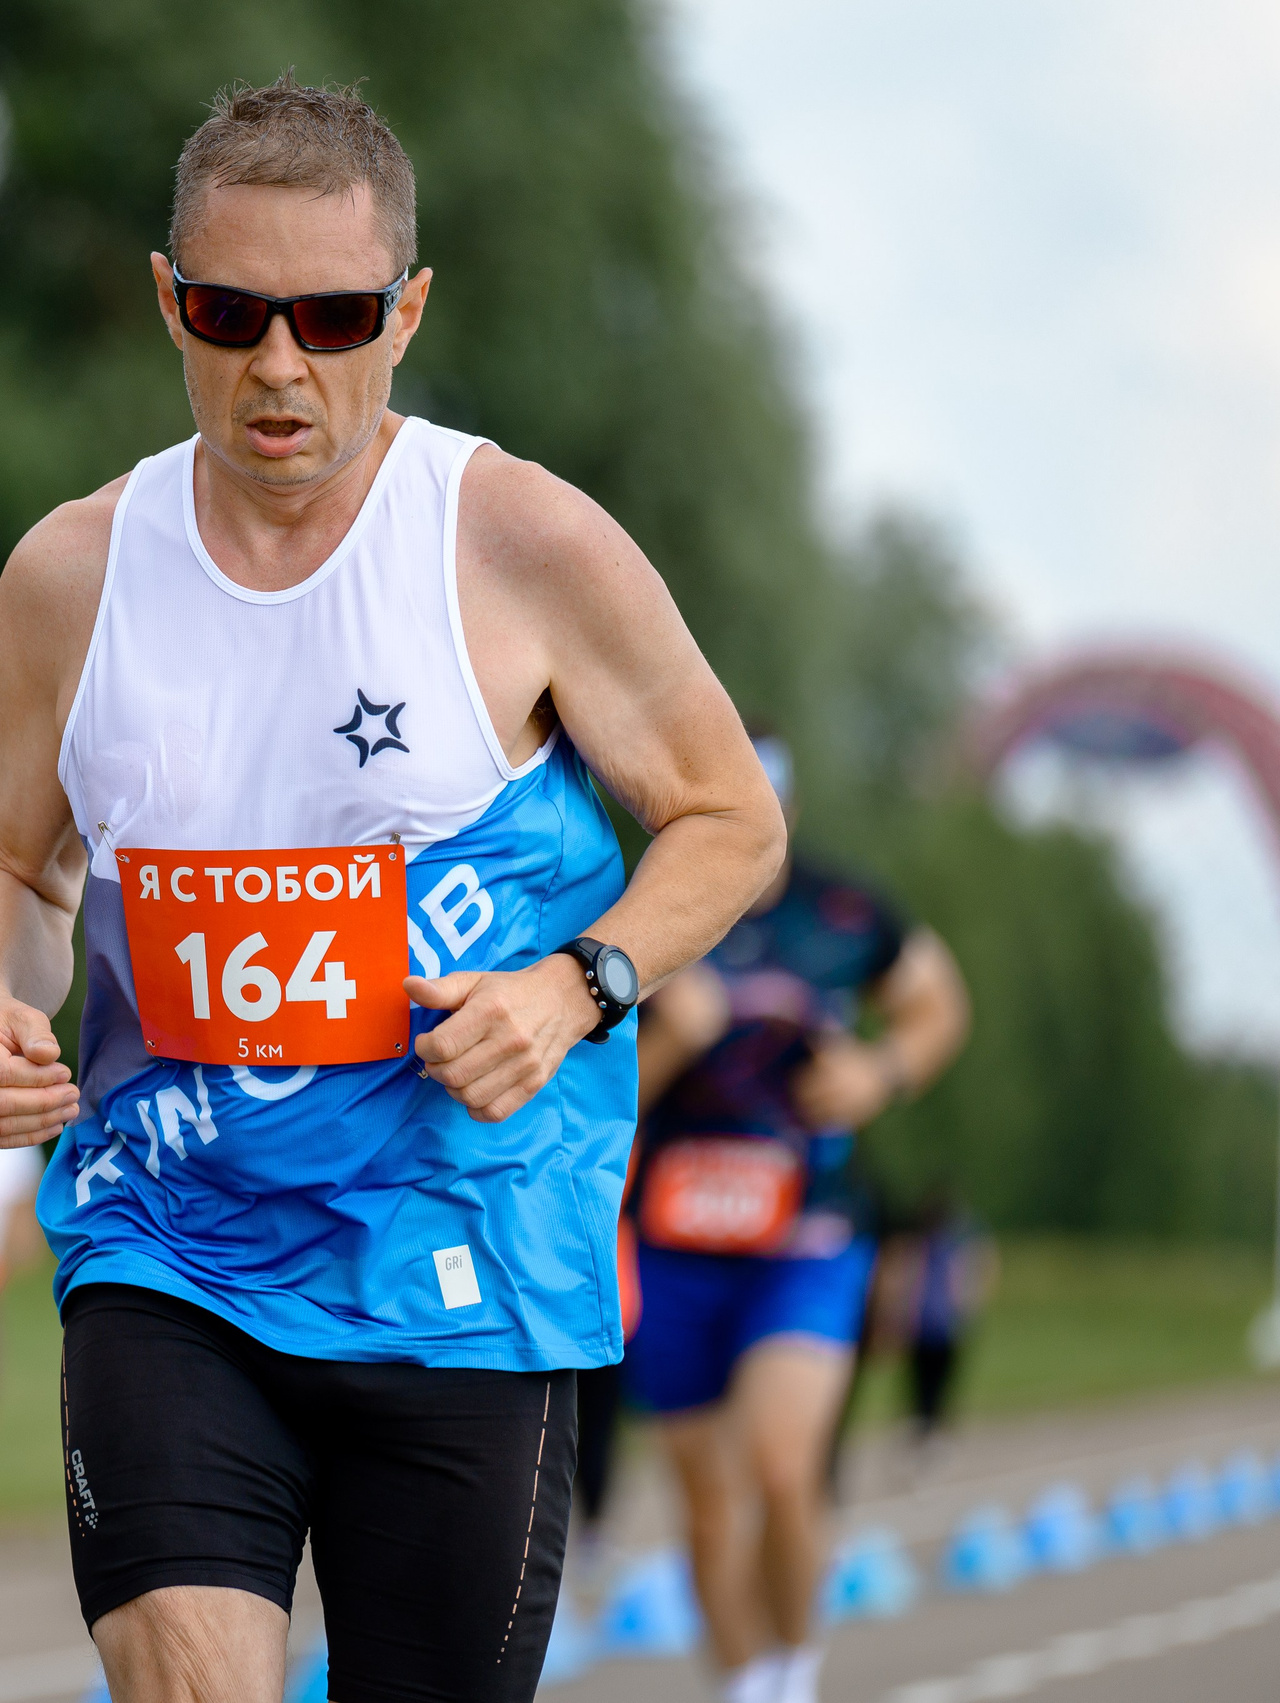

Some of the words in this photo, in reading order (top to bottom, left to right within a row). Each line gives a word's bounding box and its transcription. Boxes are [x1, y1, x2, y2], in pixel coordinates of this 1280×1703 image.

[139, 864, 160, 901] Я
[170, 866, 196, 903] С
[205, 854, 382, 904] ТОБОЙ
[174, 931, 357, 1023] 164
[237, 1038, 249, 1058] 5
[71, 1449, 96, 1509] CRAFT
